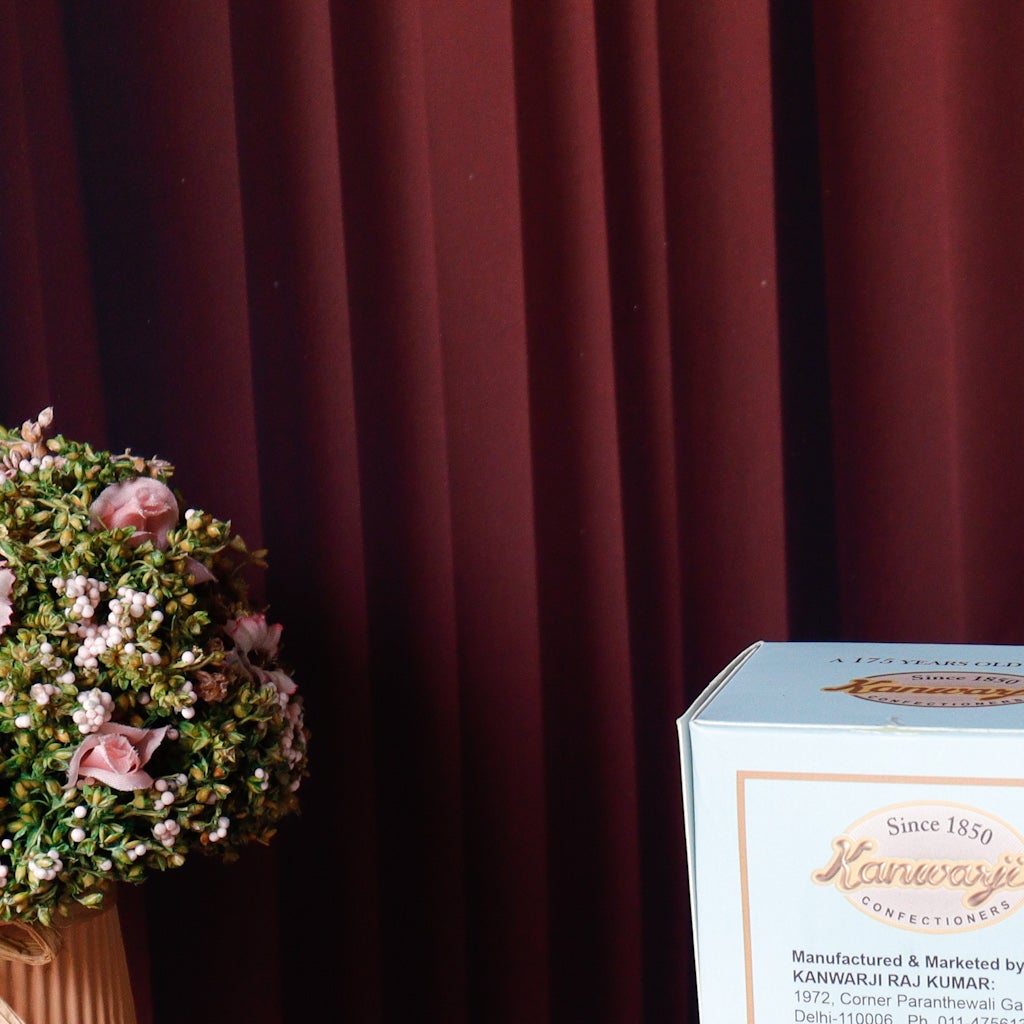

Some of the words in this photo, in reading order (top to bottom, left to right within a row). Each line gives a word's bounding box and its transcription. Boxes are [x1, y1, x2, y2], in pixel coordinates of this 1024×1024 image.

[901, 659, 969, 667] YEARS
[911, 674, 966, 682] Since
[974, 674, 1020, 685] 1850
[886, 816, 940, 836] Since
[947, 816, 993, 846] 1850
[861, 895, 1011, 926] CONFECTIONERS
[792, 949, 902, 967] Manufactured
[907, 954, 920, 968] &
[925, 955, 1000, 971] Marketed
[792, 969, 882, 987] KANWARJI
[888, 973, 921, 988] RAJ
[926, 975, 995, 991] KUMAR:
[794, 989, 835, 1007] 1972,
[839, 991, 892, 1007] Corner
[896, 993, 995, 1011] Paranthewali
